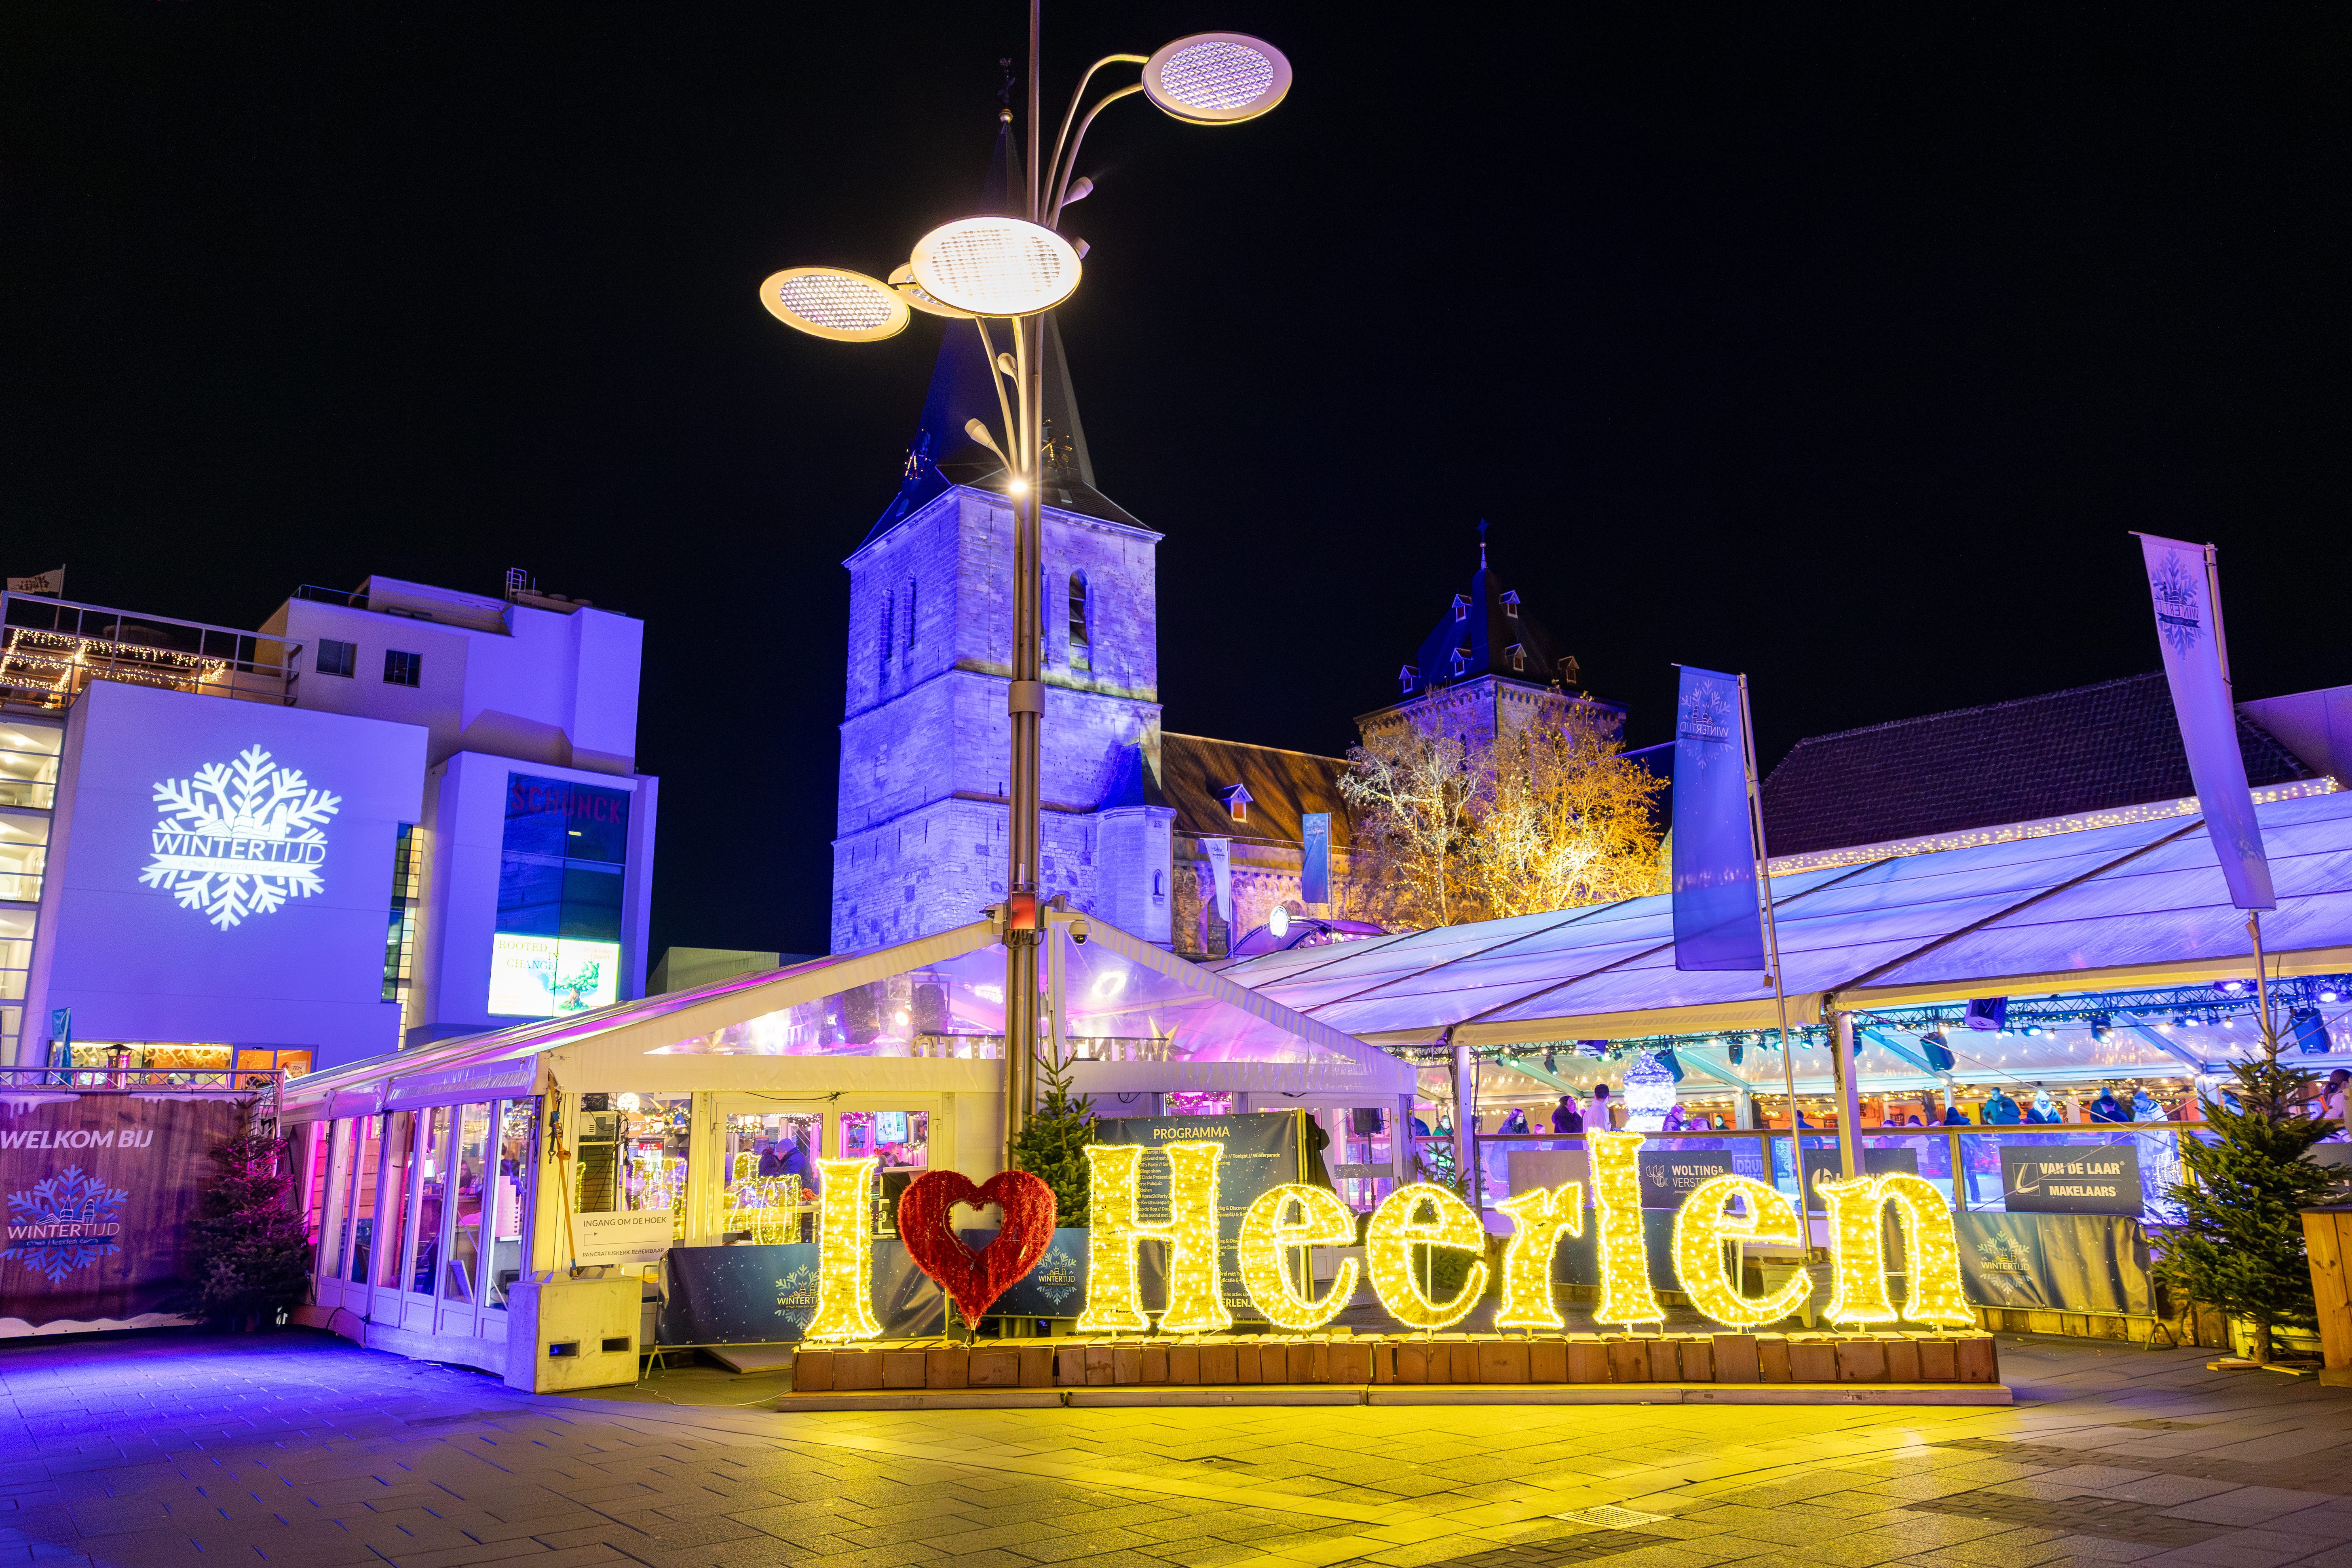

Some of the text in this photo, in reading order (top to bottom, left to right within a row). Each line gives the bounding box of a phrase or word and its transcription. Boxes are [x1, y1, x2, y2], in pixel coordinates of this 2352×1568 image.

[512, 785, 621, 824] SCHUNCK
[152, 833, 326, 863] WINTERTIJD
[499, 940, 547, 952] ROOTED
[507, 959, 555, 970] CHANGE
[1153, 1126, 1230, 1139] PROGRAMMA
[0, 1130, 154, 1149] WELKOM BIJ
[2040, 1163, 2120, 1174] VAN DE LAAR
[2049, 1186, 2116, 1197] MAKELAARS
[584, 1219, 615, 1227] INGANG
[8, 1222, 120, 1239] WINTERTIJD
[804, 1127, 1975, 1341] I Heerlen
[1981, 1262, 2030, 1271] WINTERTIJD
